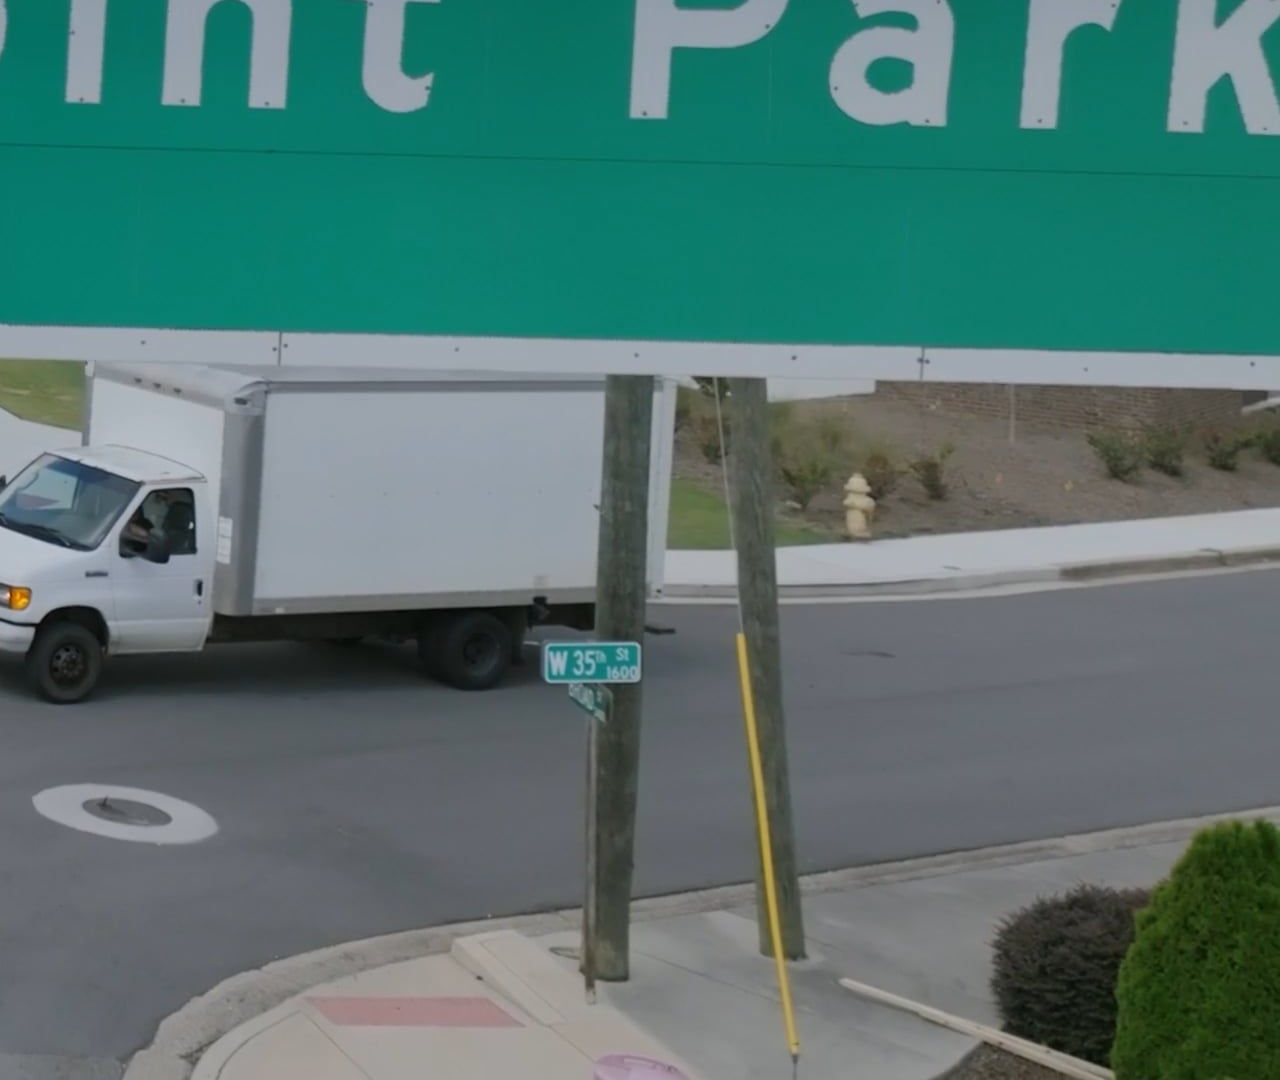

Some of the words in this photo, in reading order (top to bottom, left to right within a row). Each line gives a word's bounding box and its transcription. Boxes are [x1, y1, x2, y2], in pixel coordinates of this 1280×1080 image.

[549, 649, 569, 677] W
[615, 647, 630, 662] St
[606, 665, 638, 681] 1600
